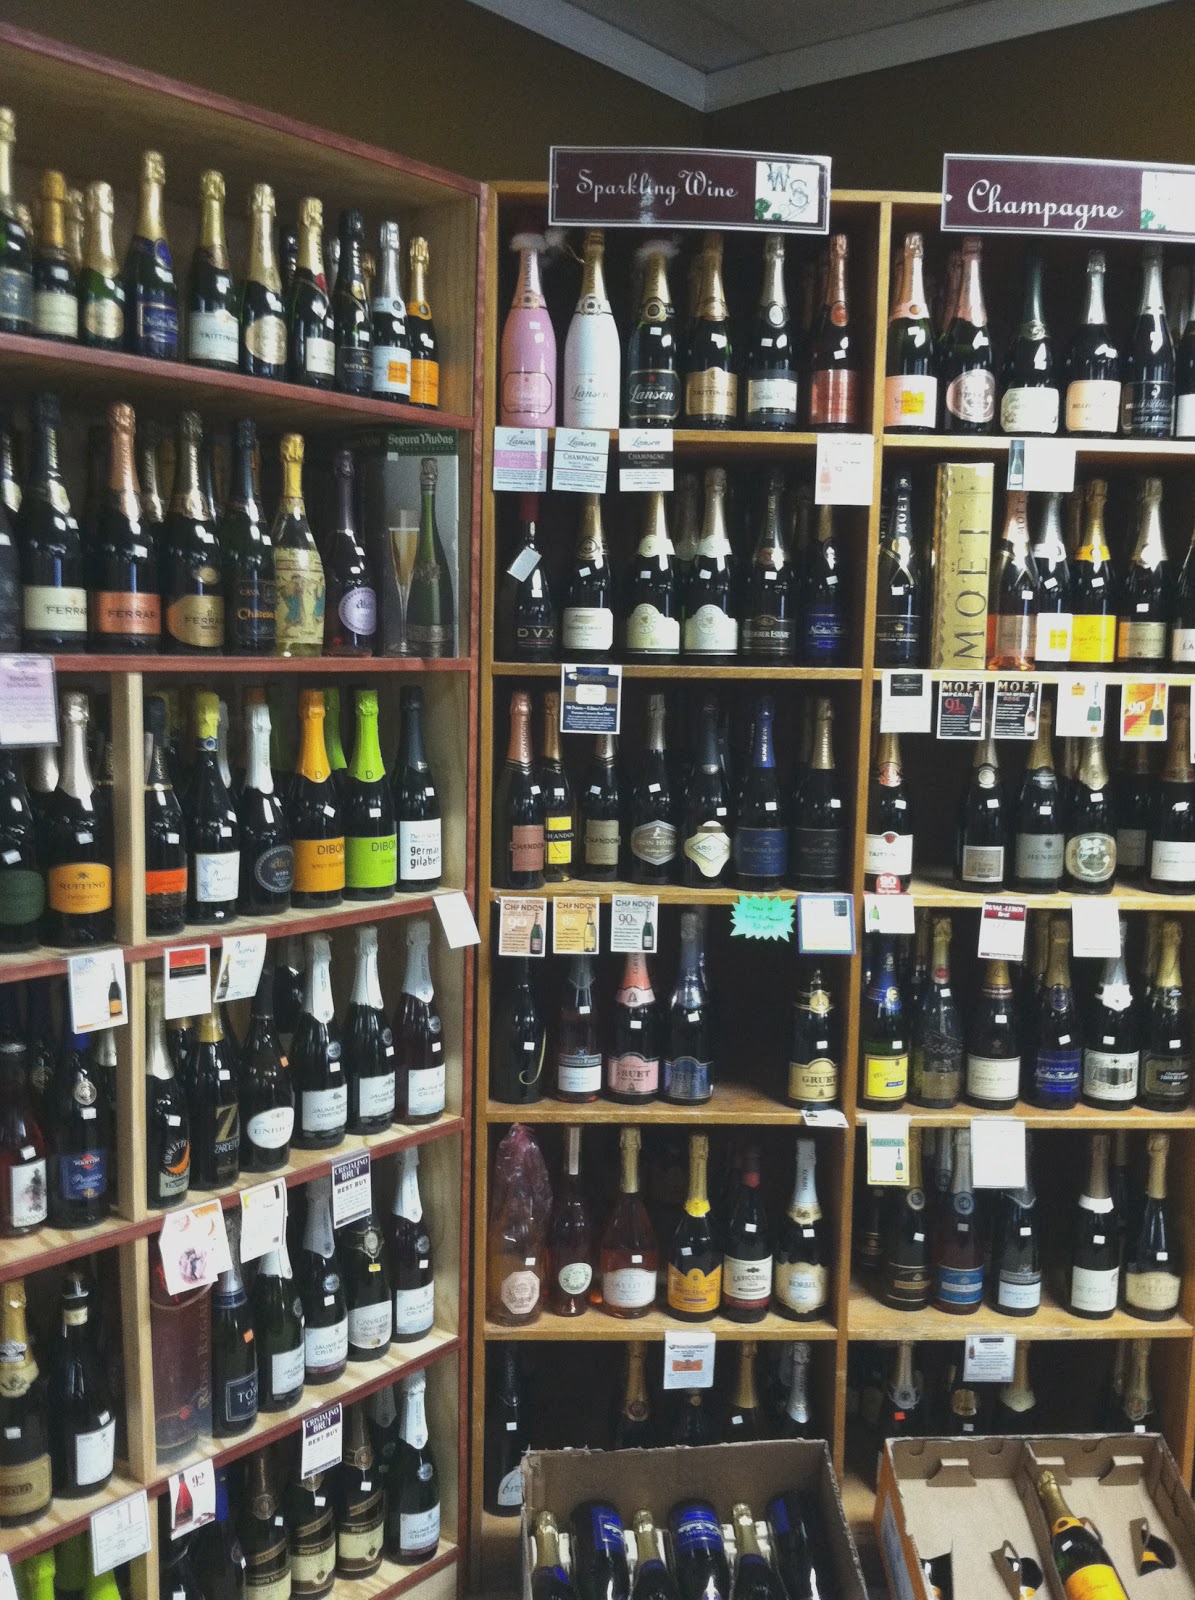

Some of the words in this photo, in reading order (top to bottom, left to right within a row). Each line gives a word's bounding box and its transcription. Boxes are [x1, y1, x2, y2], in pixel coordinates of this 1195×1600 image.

[576, 169, 679, 206] Sparkling
[678, 170, 738, 198] Wine
[967, 179, 1123, 231] Champagne
[630, 384, 675, 404] Lanson
[505, 435, 536, 447] Lanson
[567, 436, 598, 448] Lanson
[632, 437, 662, 448] Lanson
[563, 453, 600, 463] CHAMPAGNE
[628, 452, 666, 461] CHAMPAGNE
[216, 1103, 239, 1143] Z
[334, 1157, 369, 1176] CRISTALINO
[341, 1169, 361, 1182] BRUT
[338, 1183, 352, 1194] BEST
[354, 1177, 367, 1189] BUY
[305, 1407, 340, 1430] CRISTALINO
[312, 1420, 333, 1434] BRUT
[308, 1435, 325, 1447] BEST
[327, 1428, 339, 1440] BUY
